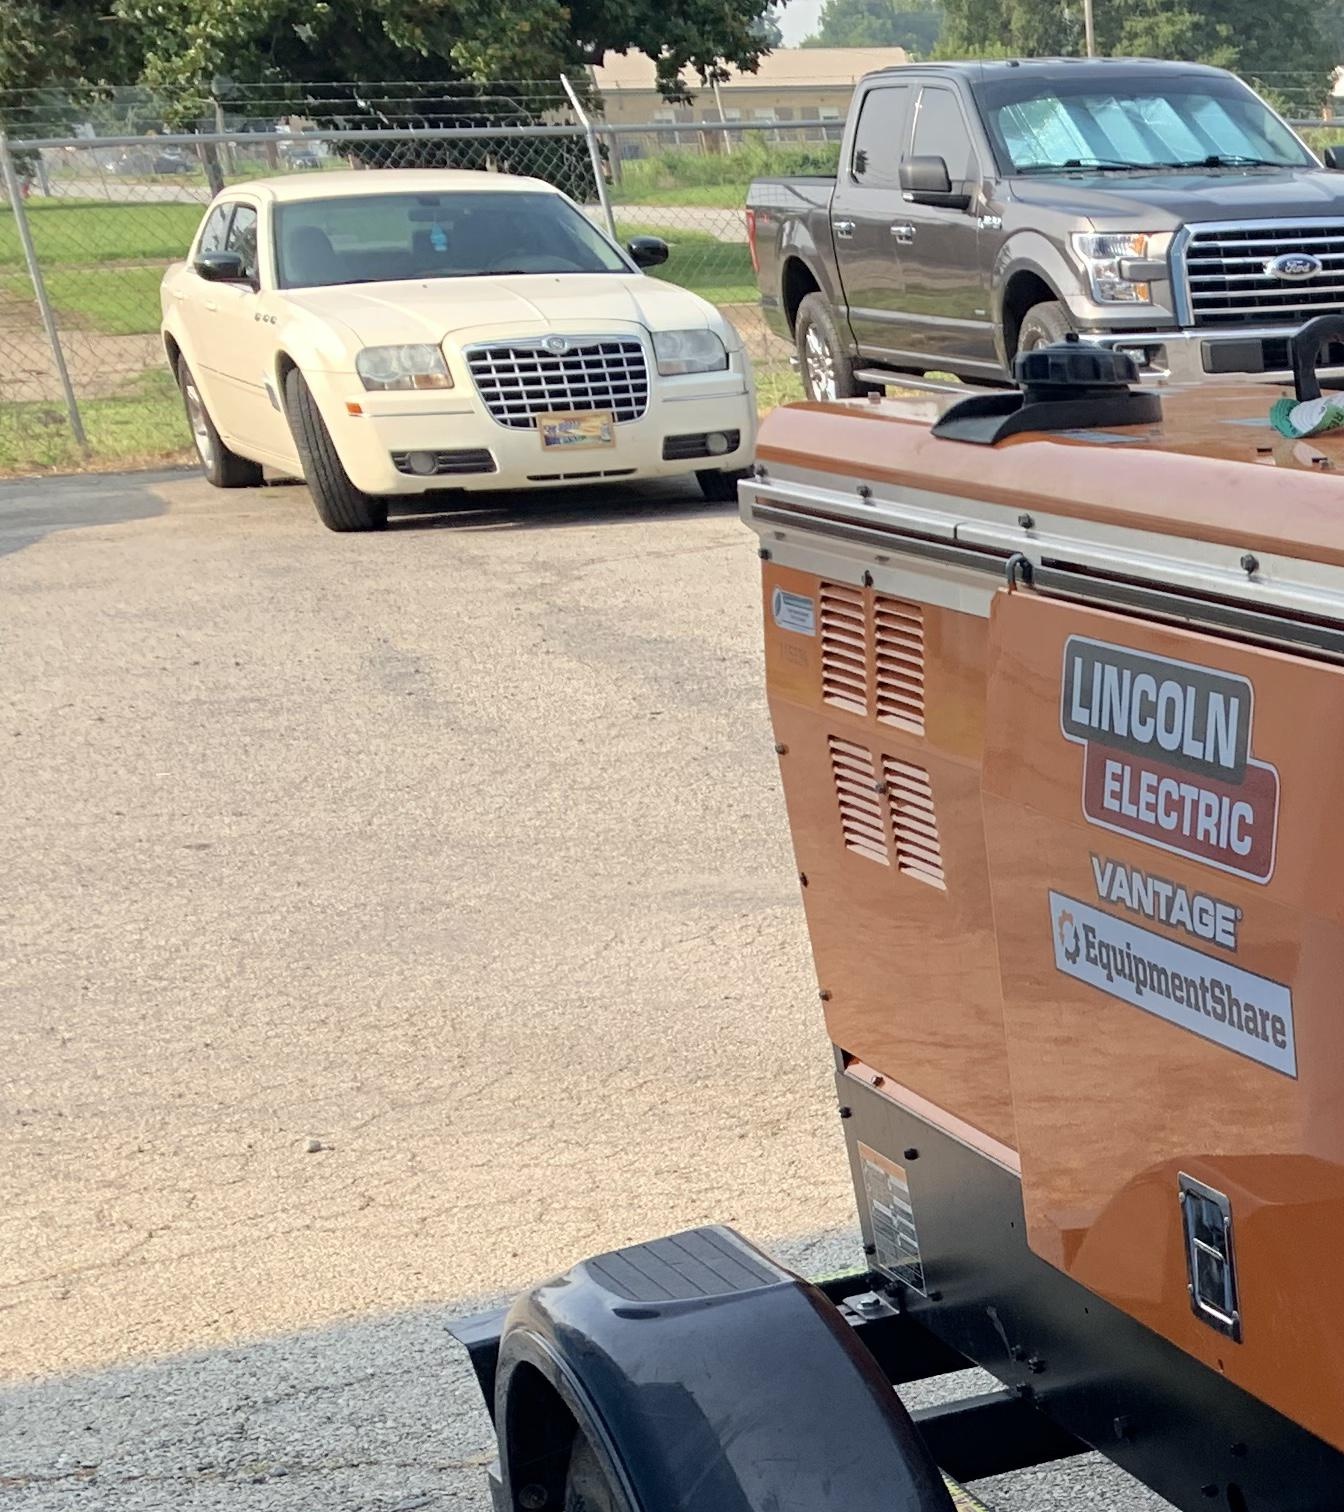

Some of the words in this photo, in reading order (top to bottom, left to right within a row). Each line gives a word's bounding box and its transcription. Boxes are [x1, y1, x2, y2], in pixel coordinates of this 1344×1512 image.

[1071, 656, 1240, 769] LINCOLN
[1103, 759, 1254, 856] ELECTRIC
[1092, 856, 1236, 949] VANTAGE
[1083, 921, 1287, 1050] EquipmentShare
